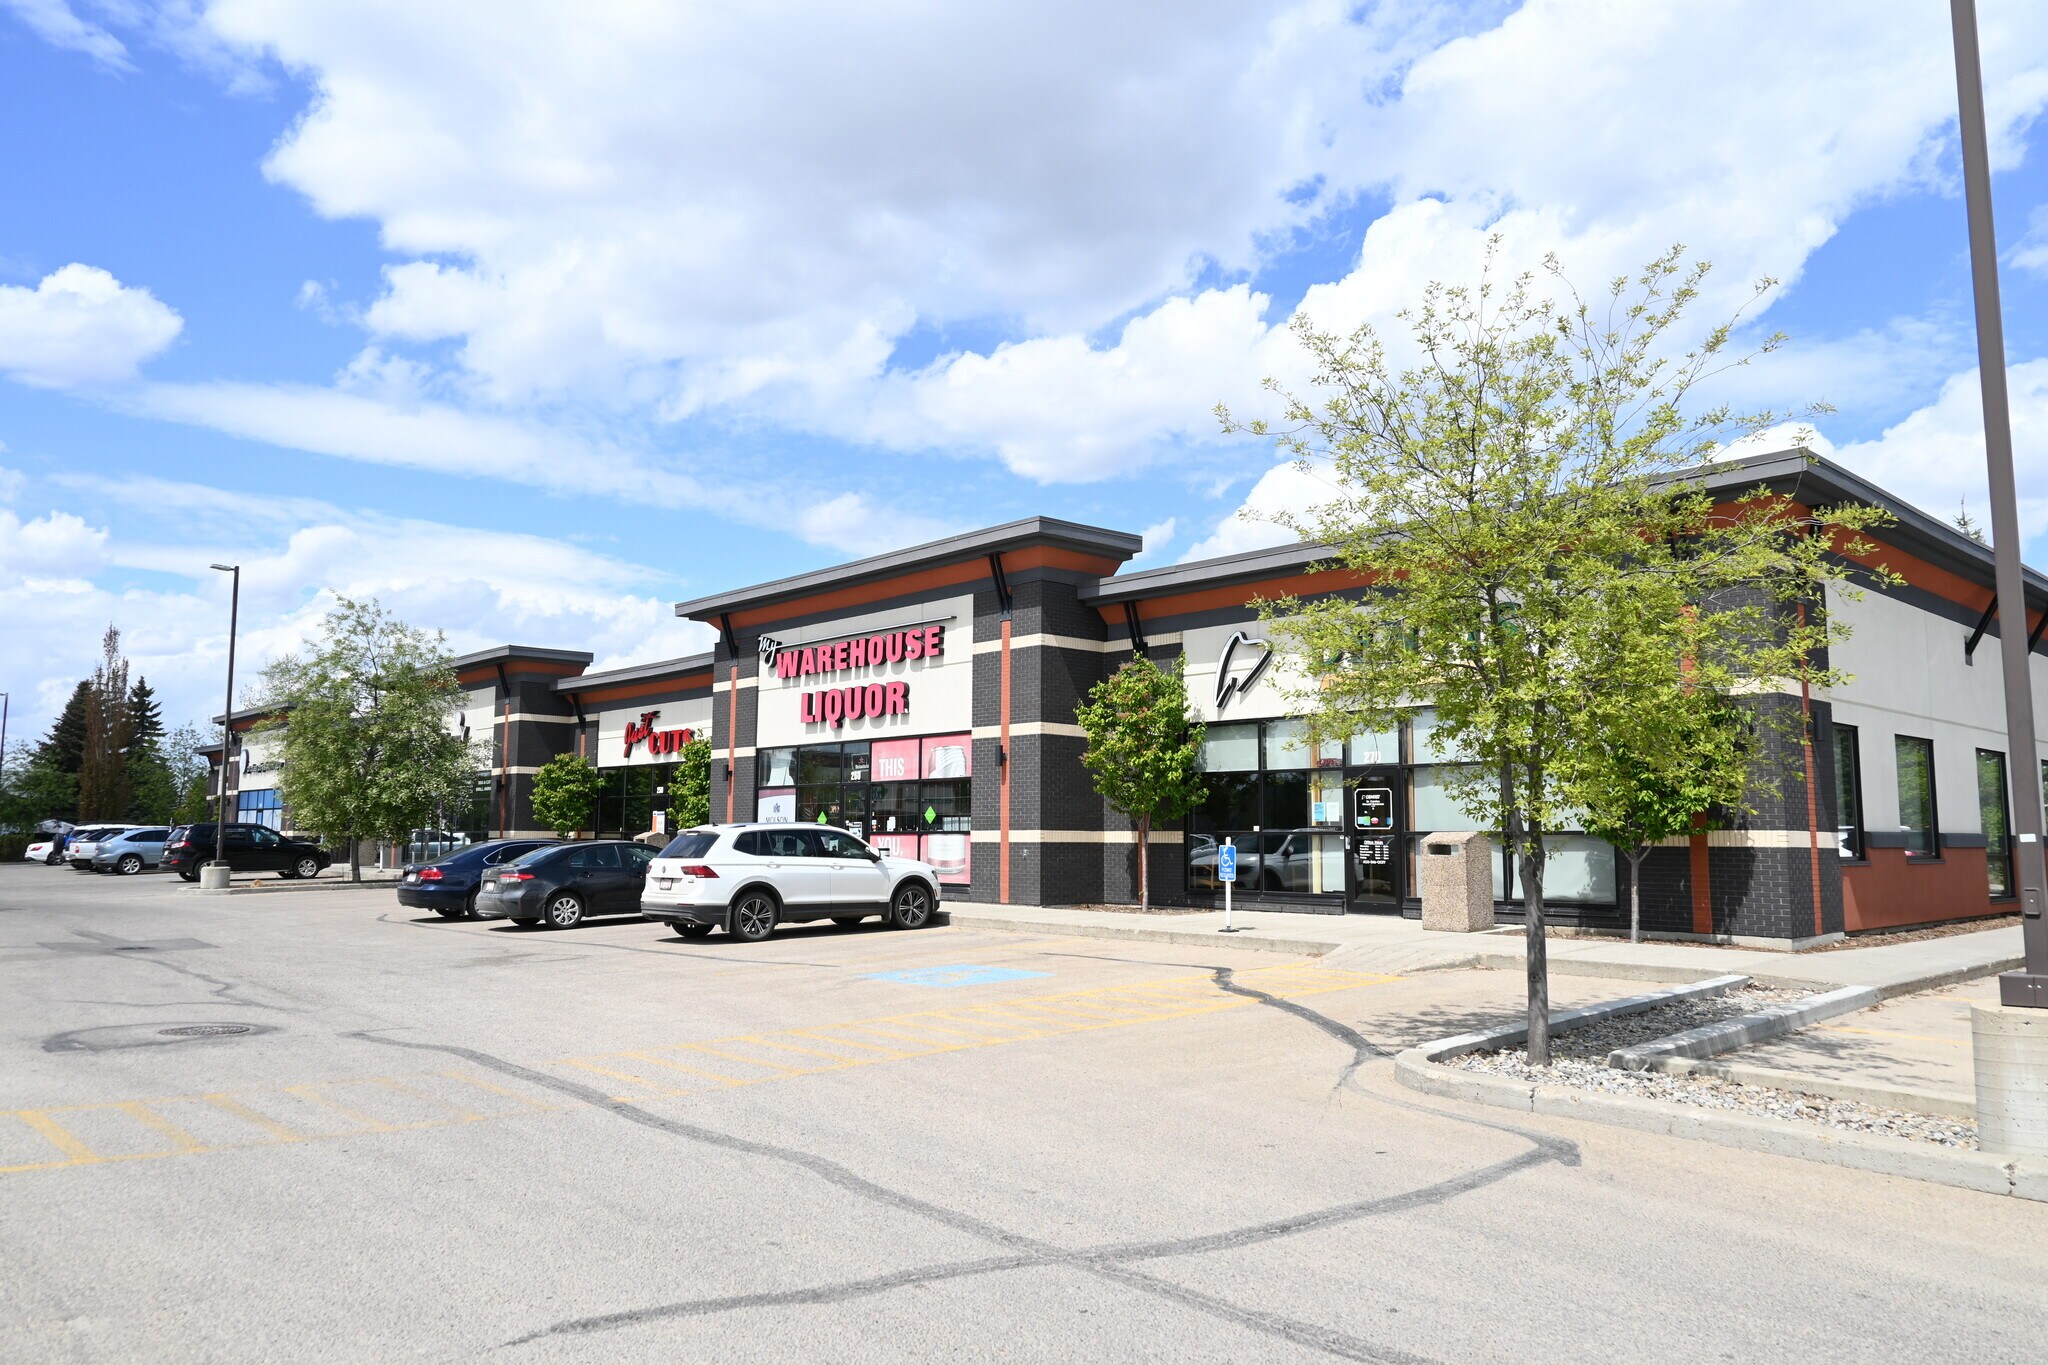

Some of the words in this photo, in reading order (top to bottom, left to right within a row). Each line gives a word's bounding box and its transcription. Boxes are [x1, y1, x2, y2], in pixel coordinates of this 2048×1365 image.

[758, 636, 782, 668] My
[776, 625, 945, 679] WAREHOUSE
[801, 681, 909, 728] LIQUOR
[624, 711, 660, 758] Just
[879, 757, 904, 777] THIS
[1364, 751, 1381, 763] 270
